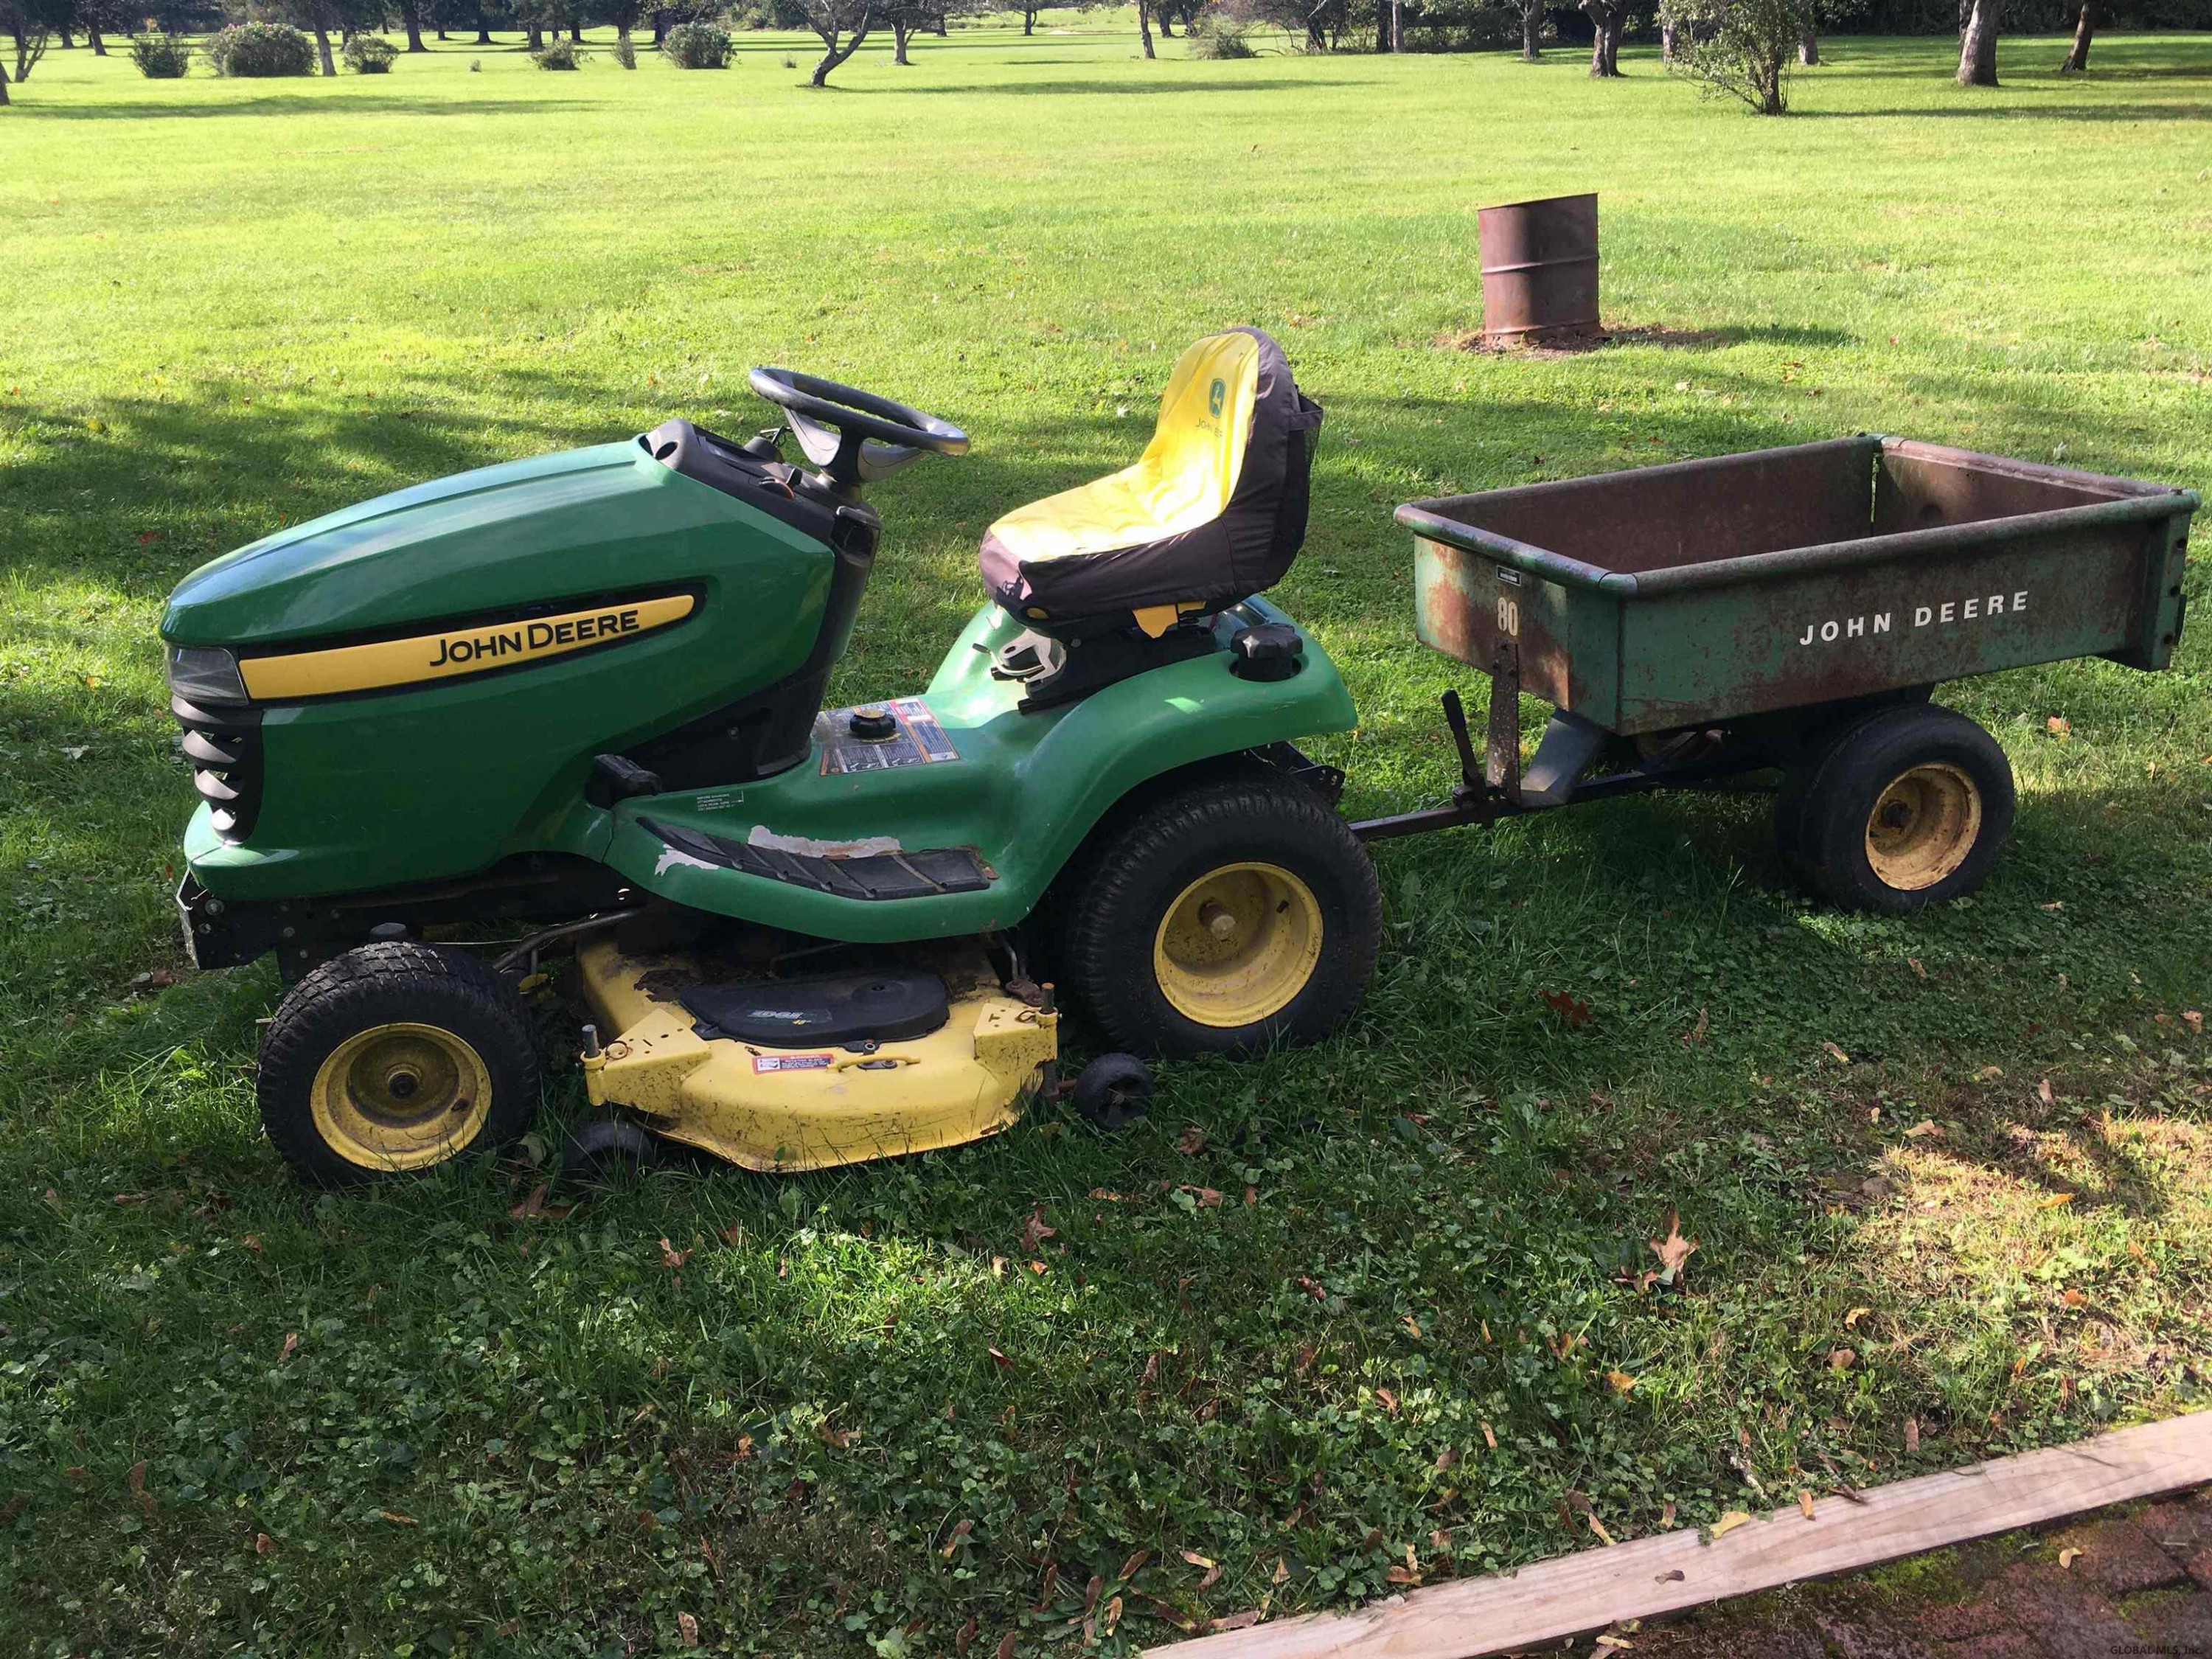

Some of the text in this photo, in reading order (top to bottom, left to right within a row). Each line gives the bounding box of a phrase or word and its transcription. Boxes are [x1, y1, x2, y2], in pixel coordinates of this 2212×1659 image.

[430, 610, 640, 667] JOHN DEERE
[1498, 597, 1518, 636] 80
[1799, 591, 2028, 645] JOHN DEERE
